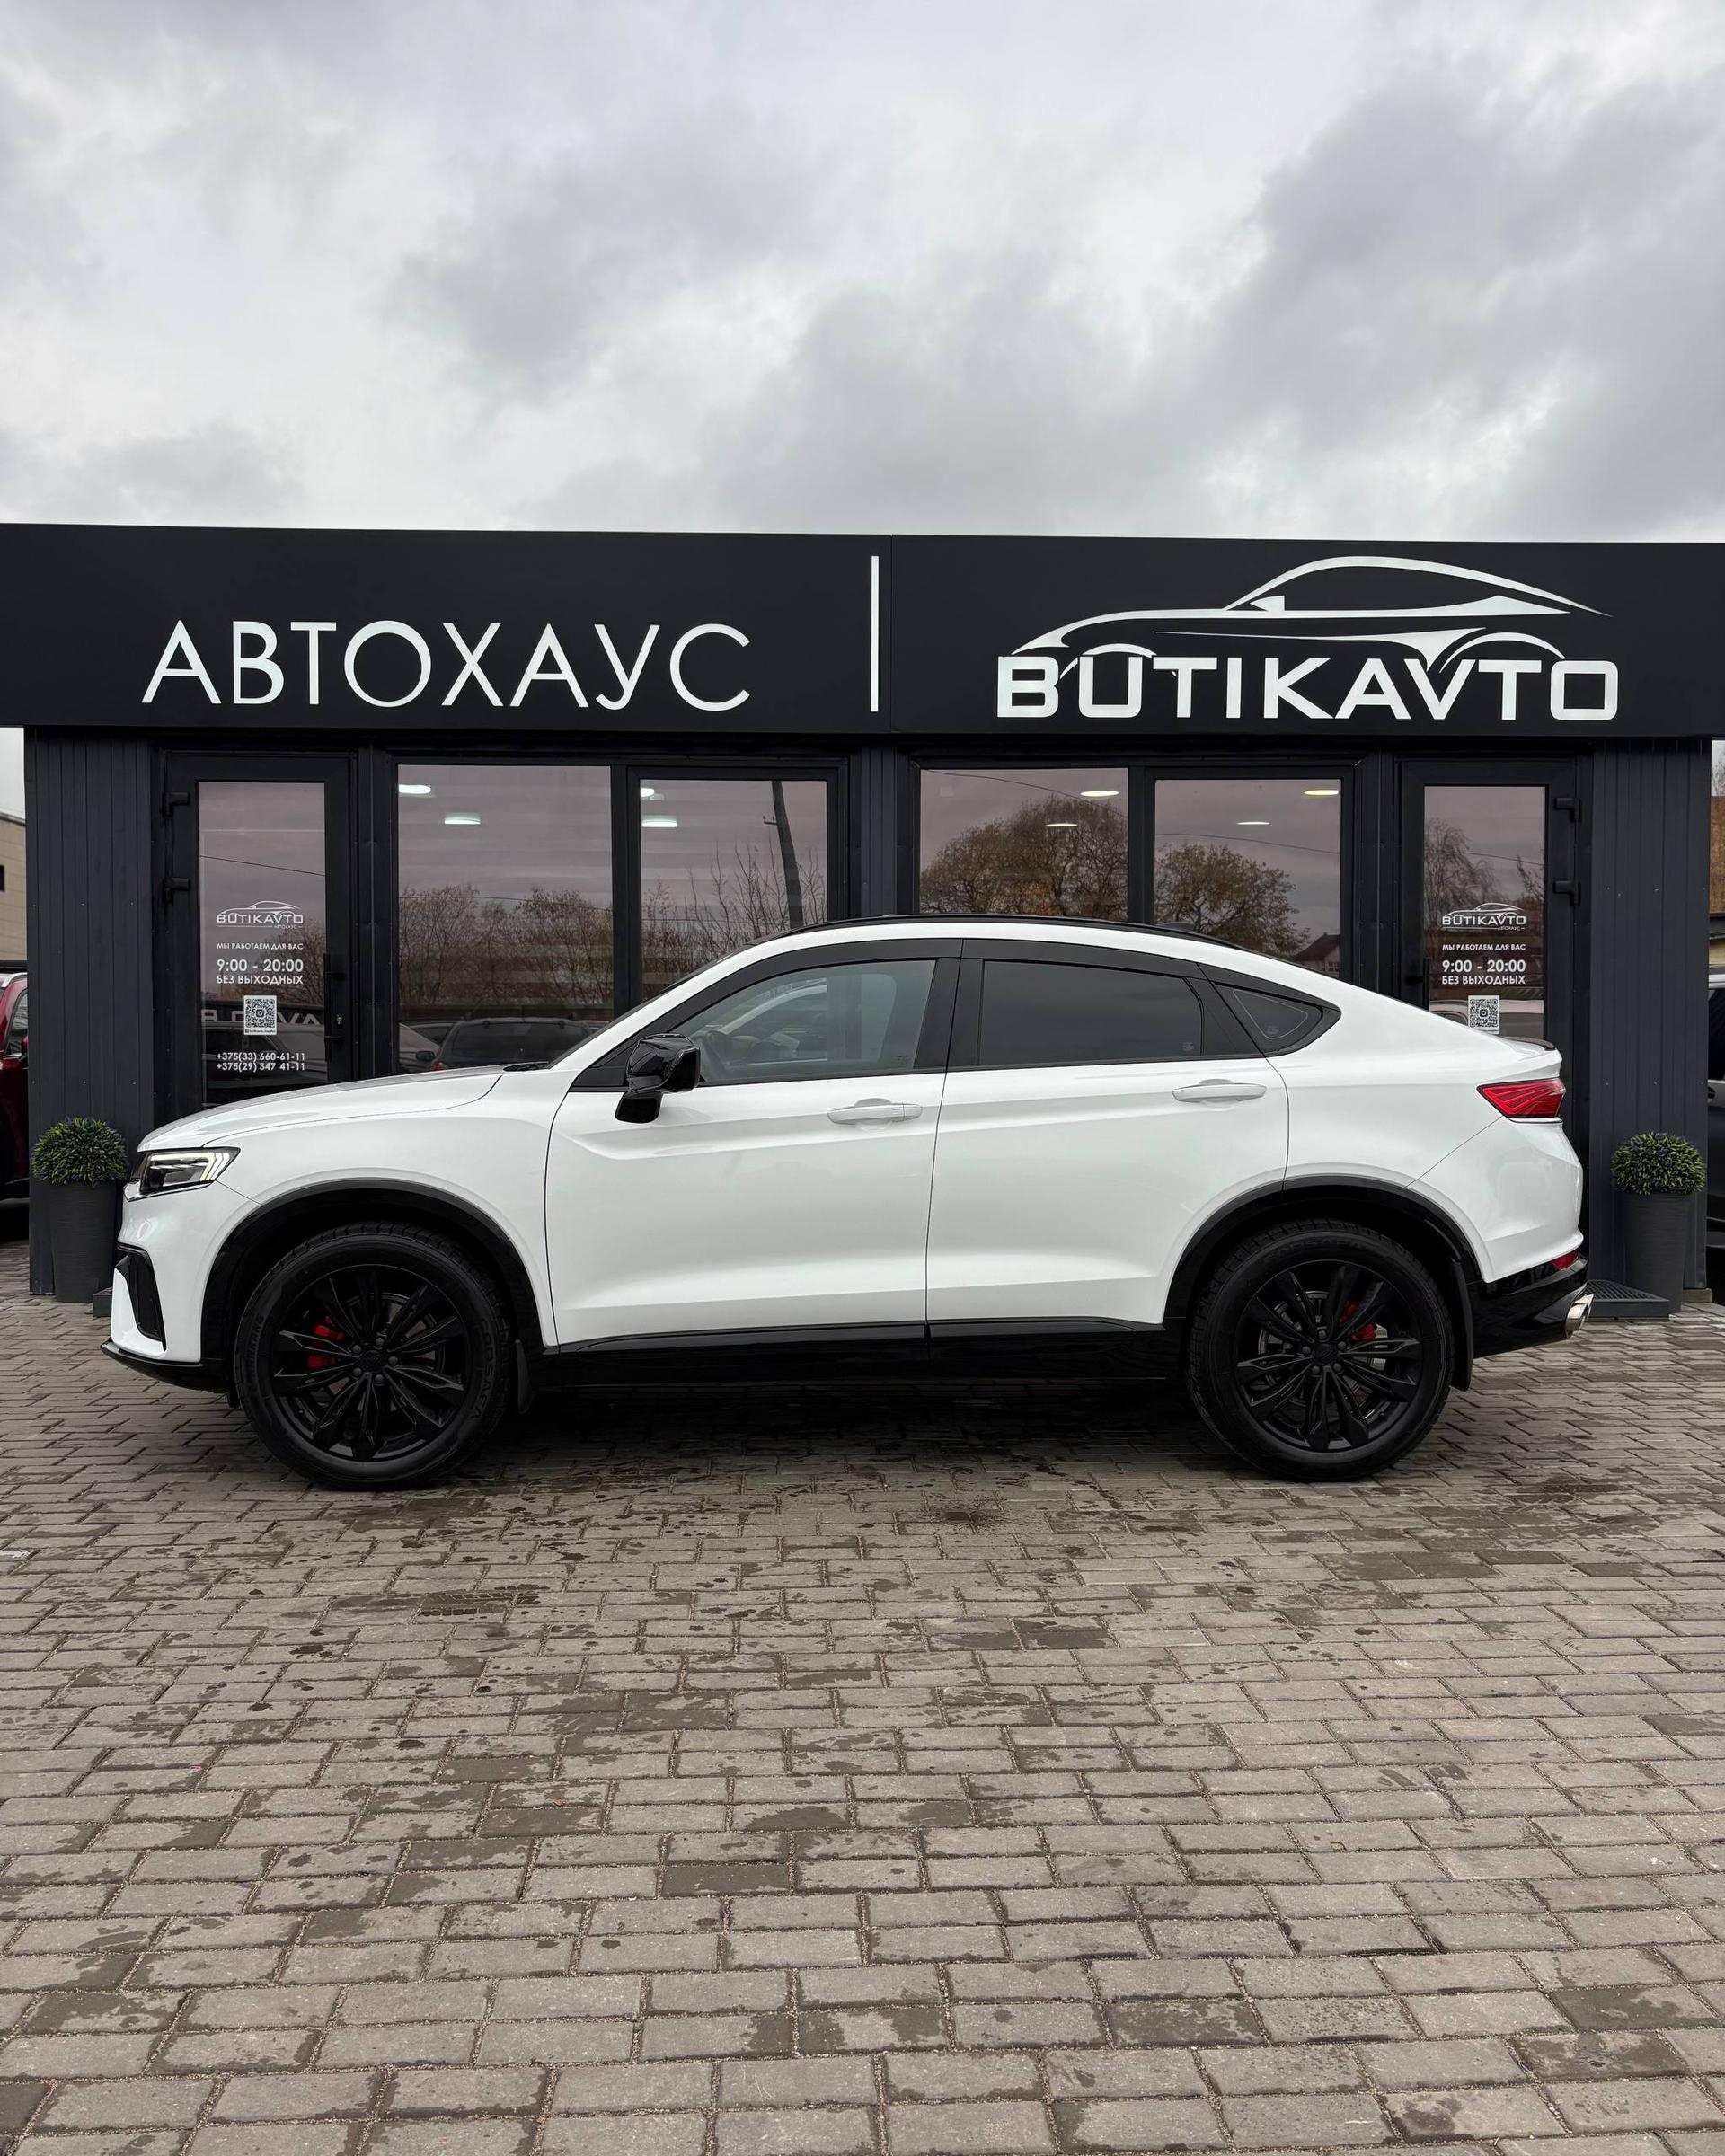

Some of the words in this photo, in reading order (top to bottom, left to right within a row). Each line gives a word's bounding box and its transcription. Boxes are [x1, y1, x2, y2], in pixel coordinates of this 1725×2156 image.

[141, 620, 751, 711] АВТОХАУС
[996, 655, 1619, 720] BUTIKAVTO
[217, 914, 304, 923] BUTIKAVTO
[1442, 915, 1526, 925] BUTIKAVTO
[217, 959, 248, 972] 9:00
[263, 959, 304, 972] 20:00
[1442, 959, 1473, 973] 9:00
[1487, 959, 1526, 973] 20:00
[217, 975, 234, 984] БЕЗ
[237, 975, 304, 985] ВЫХОДНЫХ
[1442, 976, 1459, 985] БЕЗ
[1462, 976, 1526, 985] ВЫХОДНЫХ
[216, 1052, 257, 1062] +375(33)
[259, 1052, 305, 1061] 660-61-11
[216, 1062, 257, 1073] +375(29)
